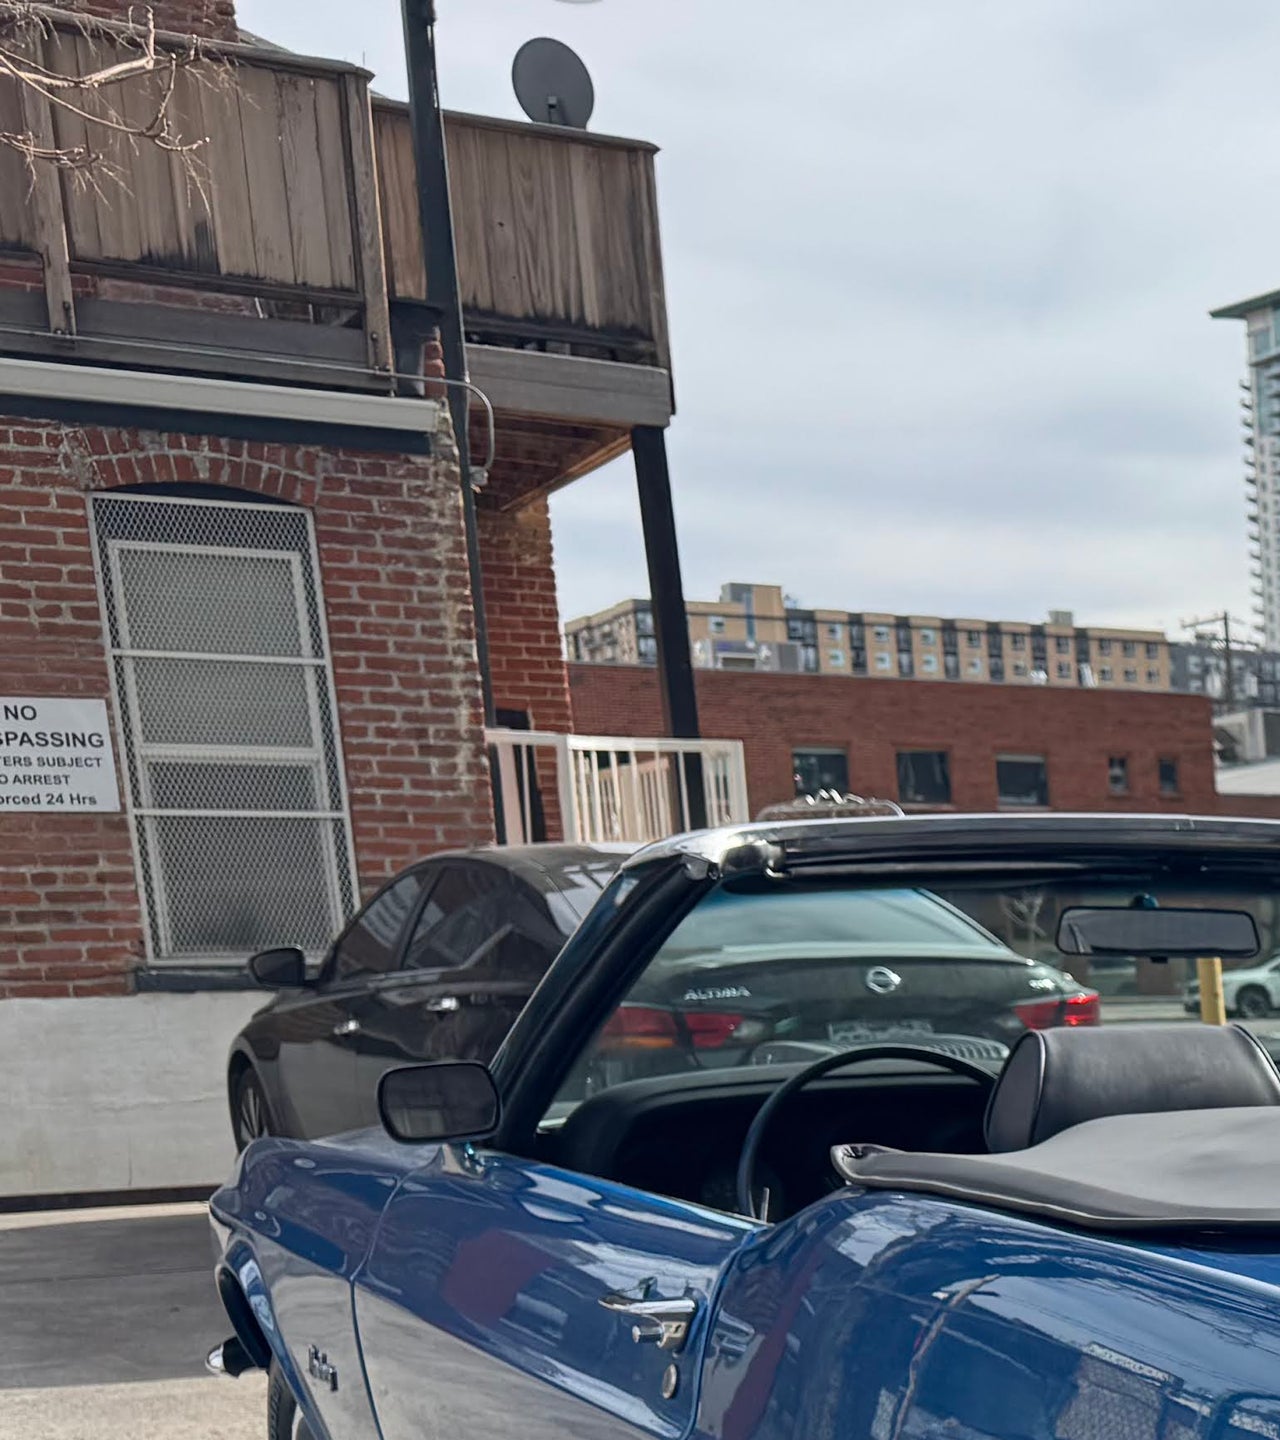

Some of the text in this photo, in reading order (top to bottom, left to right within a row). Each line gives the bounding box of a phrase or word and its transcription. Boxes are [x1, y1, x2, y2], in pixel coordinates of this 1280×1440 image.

[3, 705, 37, 721] NO
[0, 731, 105, 748] PASSING
[0, 755, 102, 768] ERS SUBJECT
[12, 774, 71, 786] ARREST
[45, 793, 65, 806] 24
[69, 792, 97, 806] Hrs
